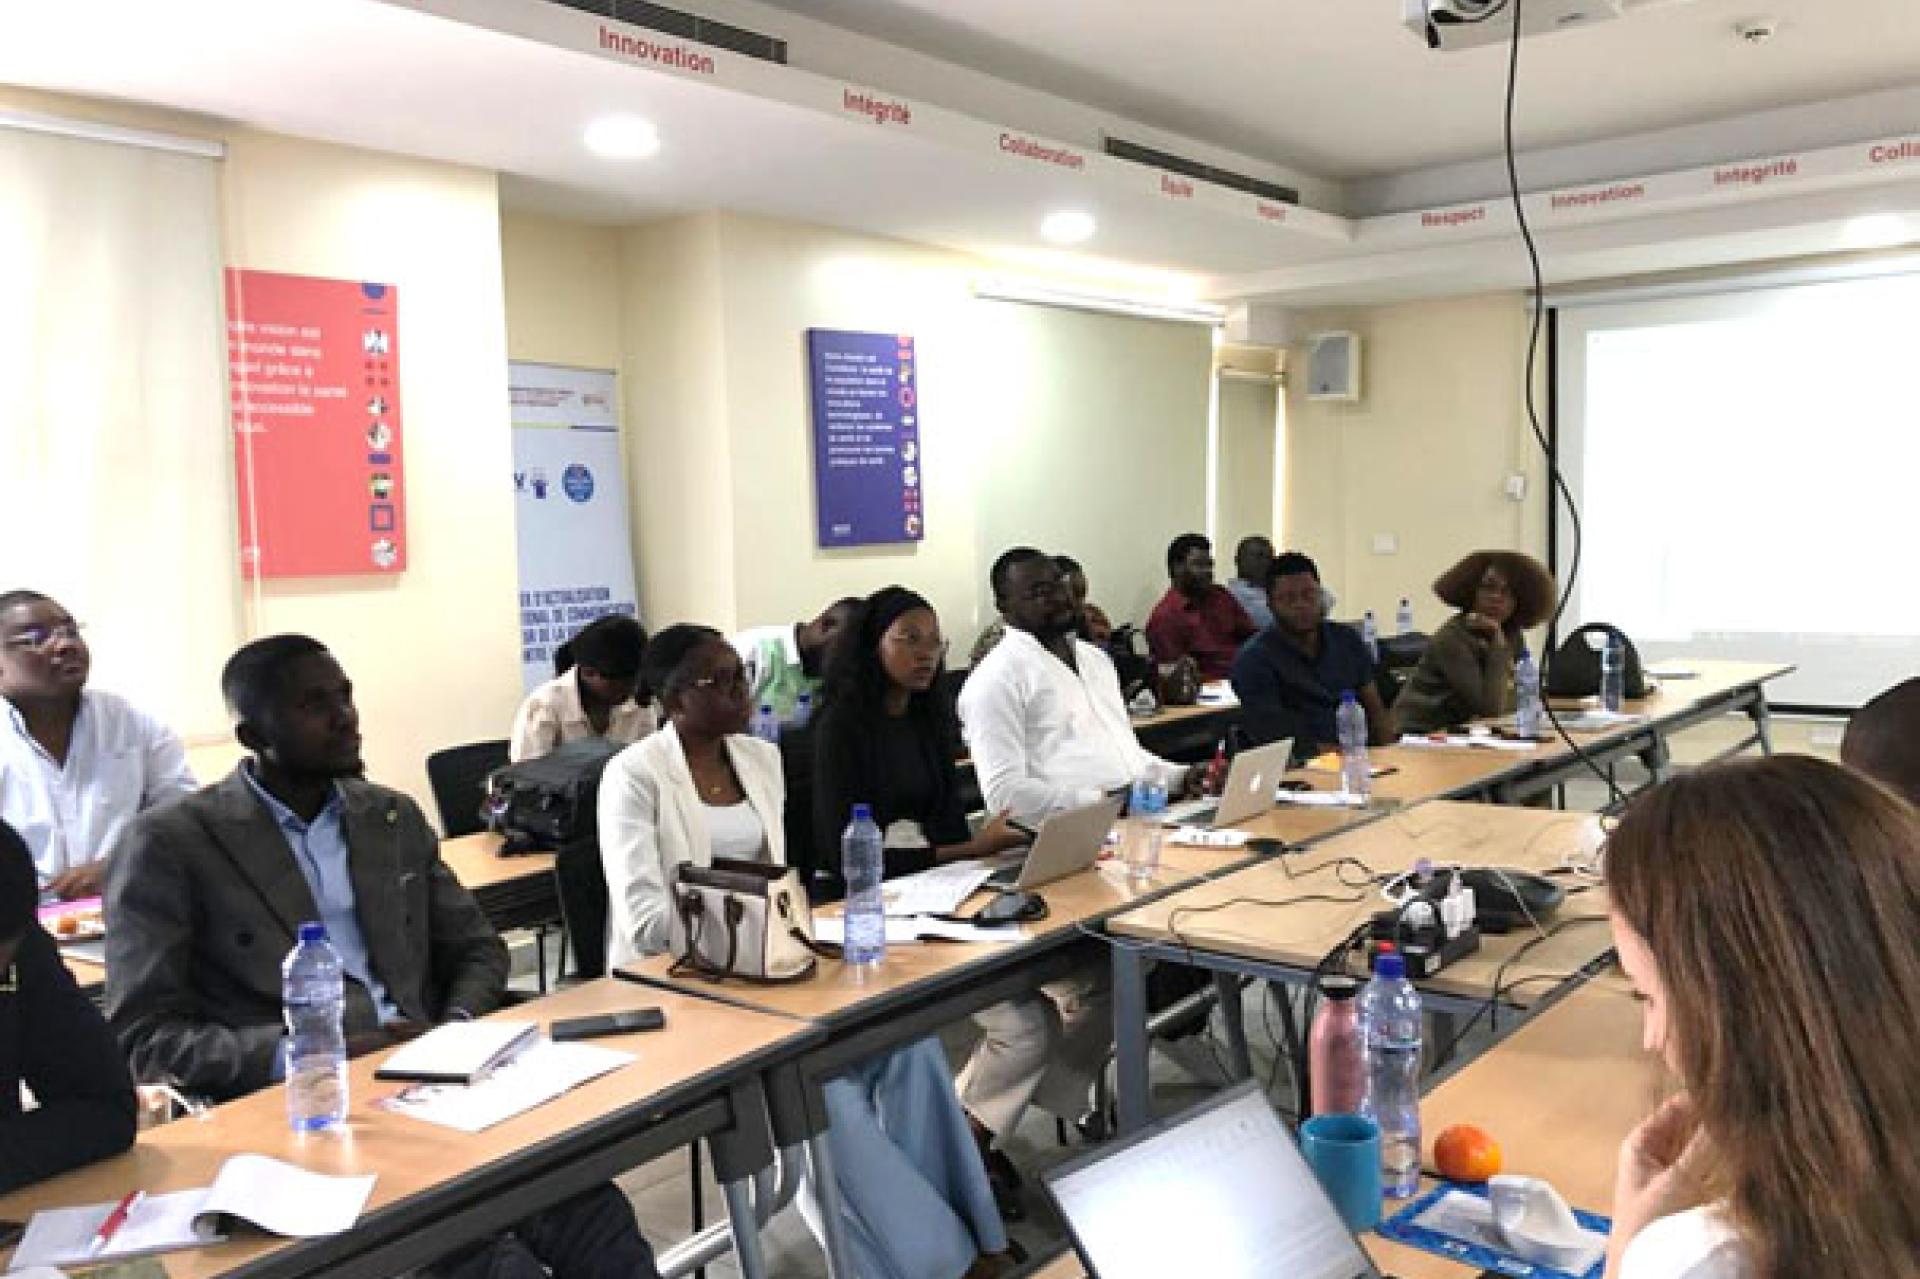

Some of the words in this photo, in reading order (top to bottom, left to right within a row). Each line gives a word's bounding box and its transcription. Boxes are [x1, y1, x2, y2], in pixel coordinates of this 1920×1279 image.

[599, 25, 714, 73] Innovation
[999, 132, 1085, 170] Collaboration
[1551, 183, 1645, 208] Innovation
[1421, 207, 1486, 227] Respect
